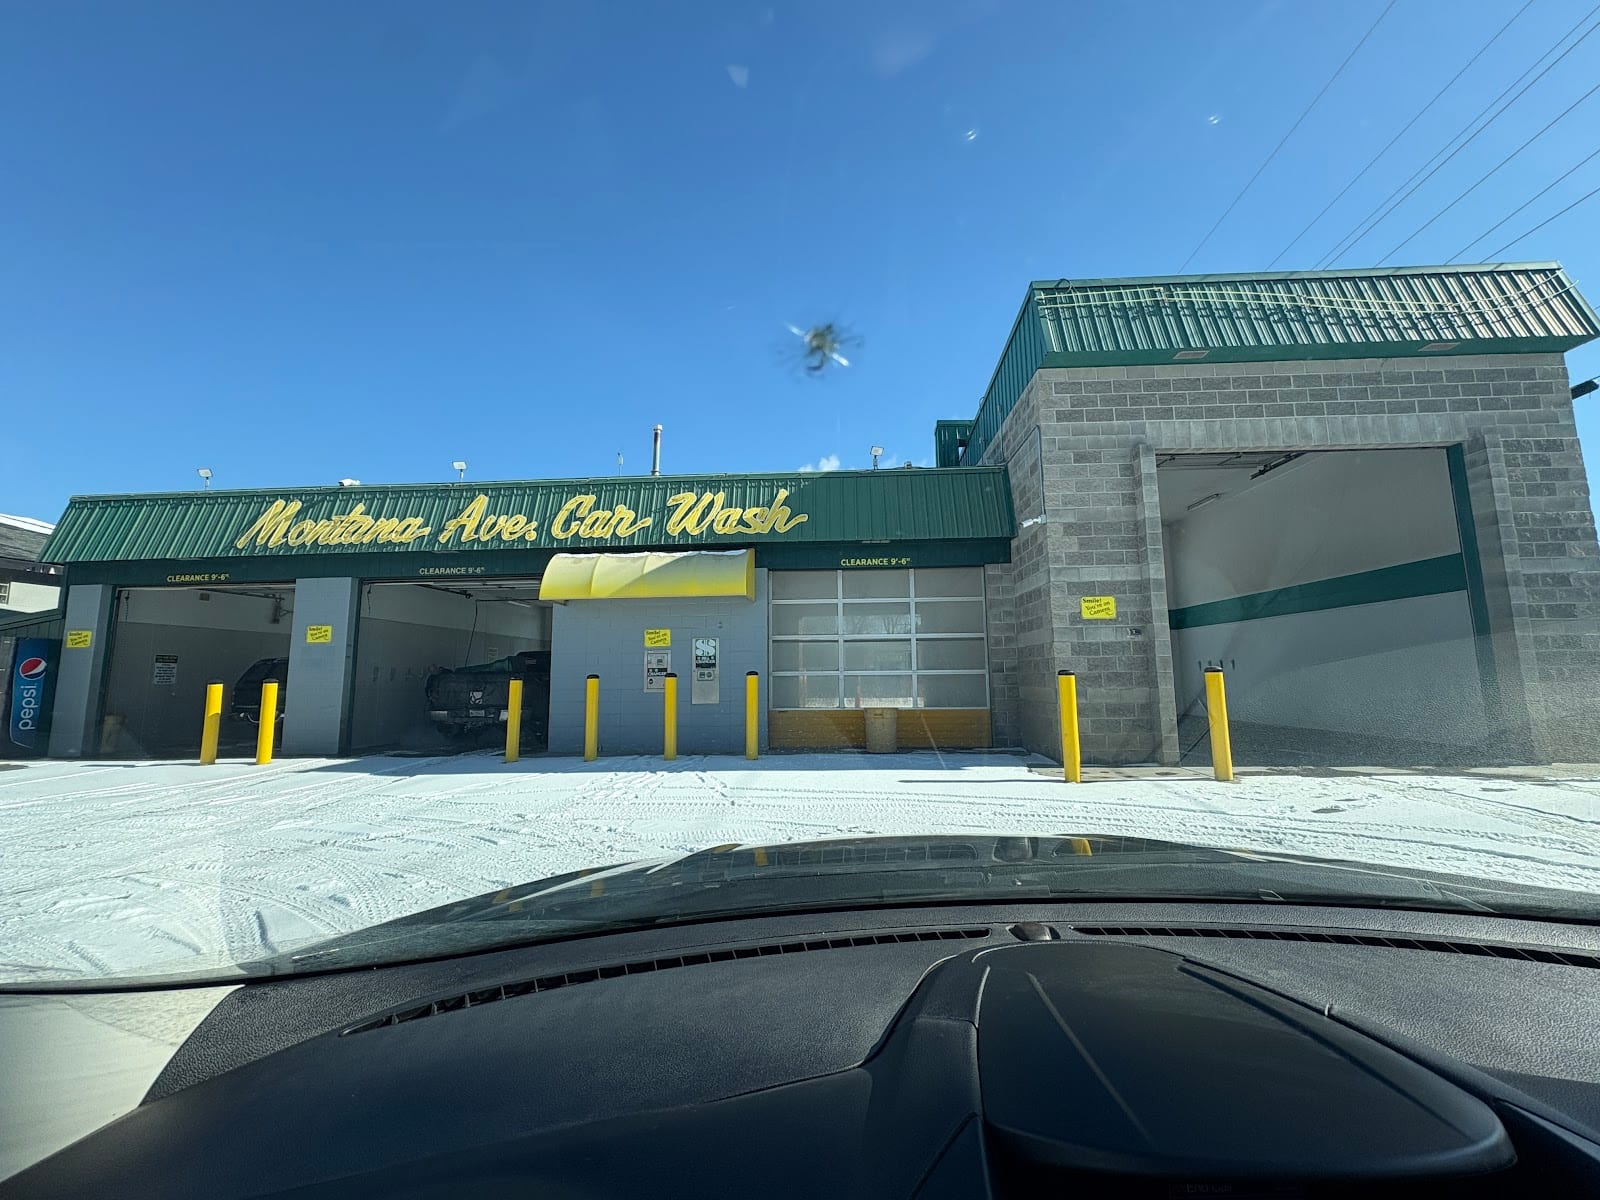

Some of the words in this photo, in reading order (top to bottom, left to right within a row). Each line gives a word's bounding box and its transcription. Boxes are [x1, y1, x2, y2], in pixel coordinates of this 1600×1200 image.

[235, 499, 431, 549] Montana
[438, 494, 537, 543] Ave.
[550, 494, 652, 540] Car
[665, 488, 809, 537] Wash
[839, 558, 889, 566] CLEARANCE
[419, 567, 466, 575] CLEARANCE
[166, 574, 209, 583] CLEARANCE
[18, 685, 39, 730] pepsi
